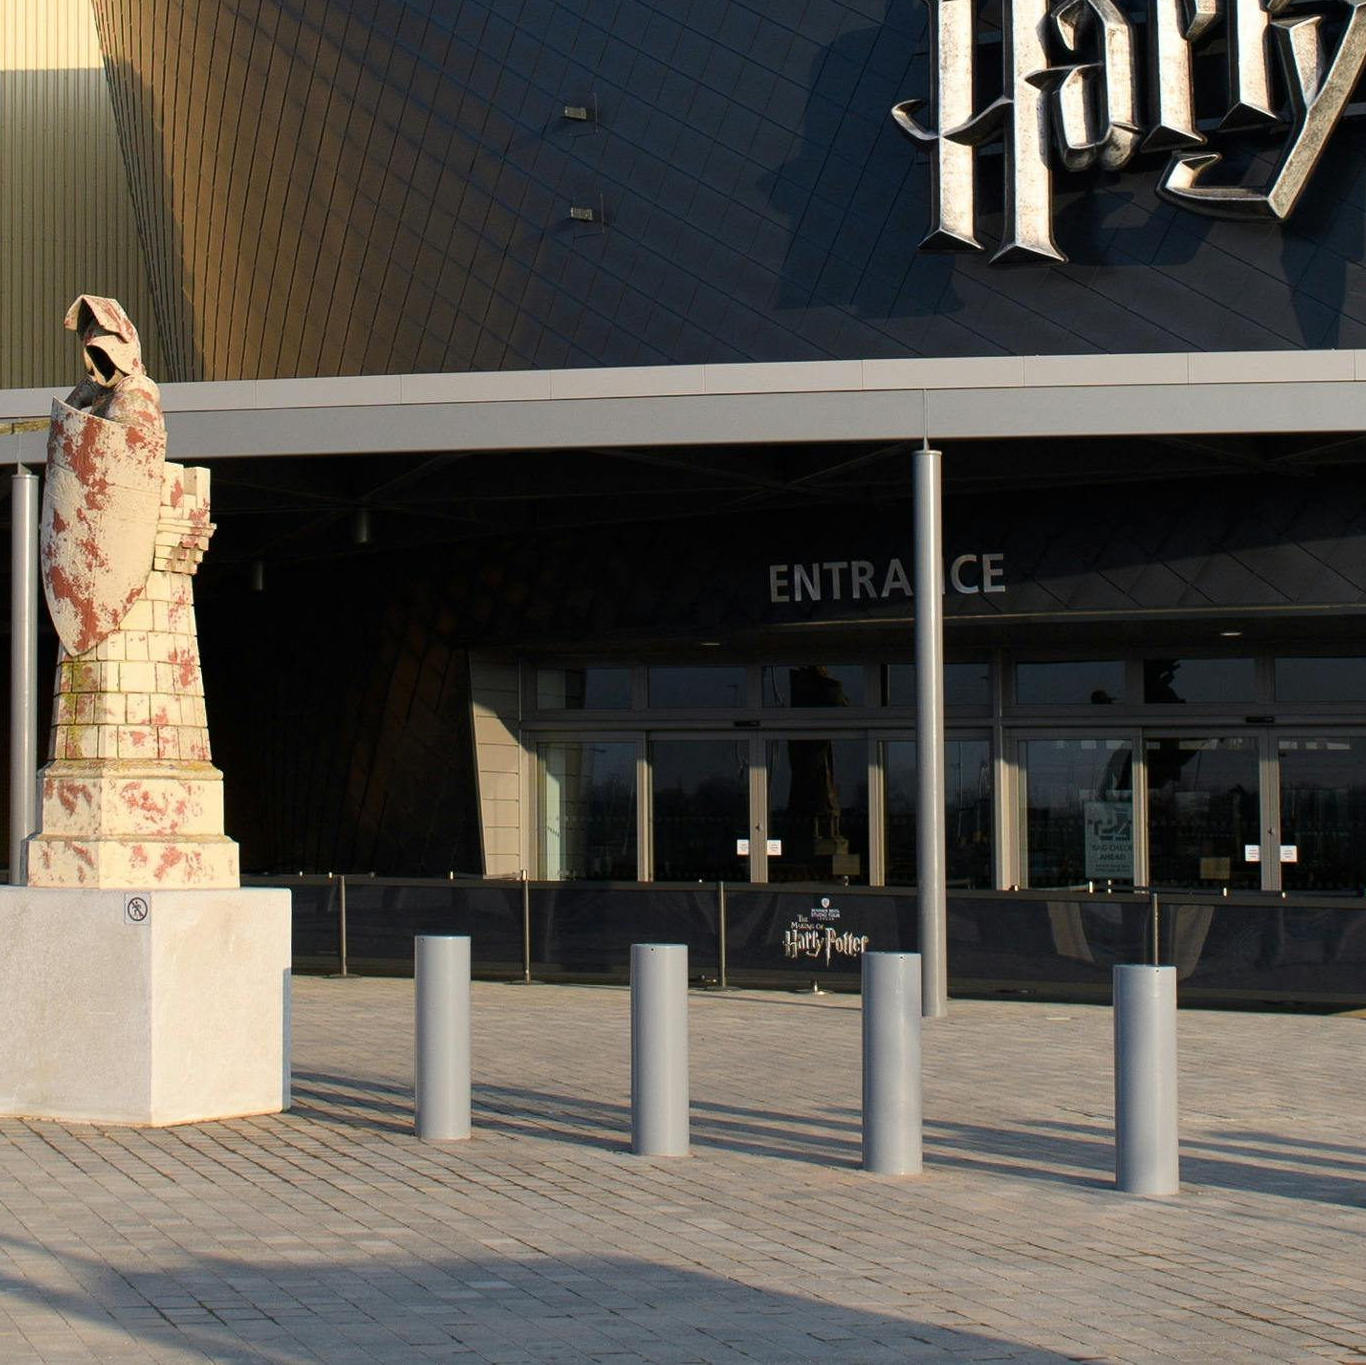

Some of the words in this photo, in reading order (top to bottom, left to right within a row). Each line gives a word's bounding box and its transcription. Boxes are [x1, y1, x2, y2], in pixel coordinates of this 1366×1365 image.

[768, 553, 1007, 603] ENTRACE
[781, 929, 825, 959] Harry
[825, 927, 870, 968] Potter
